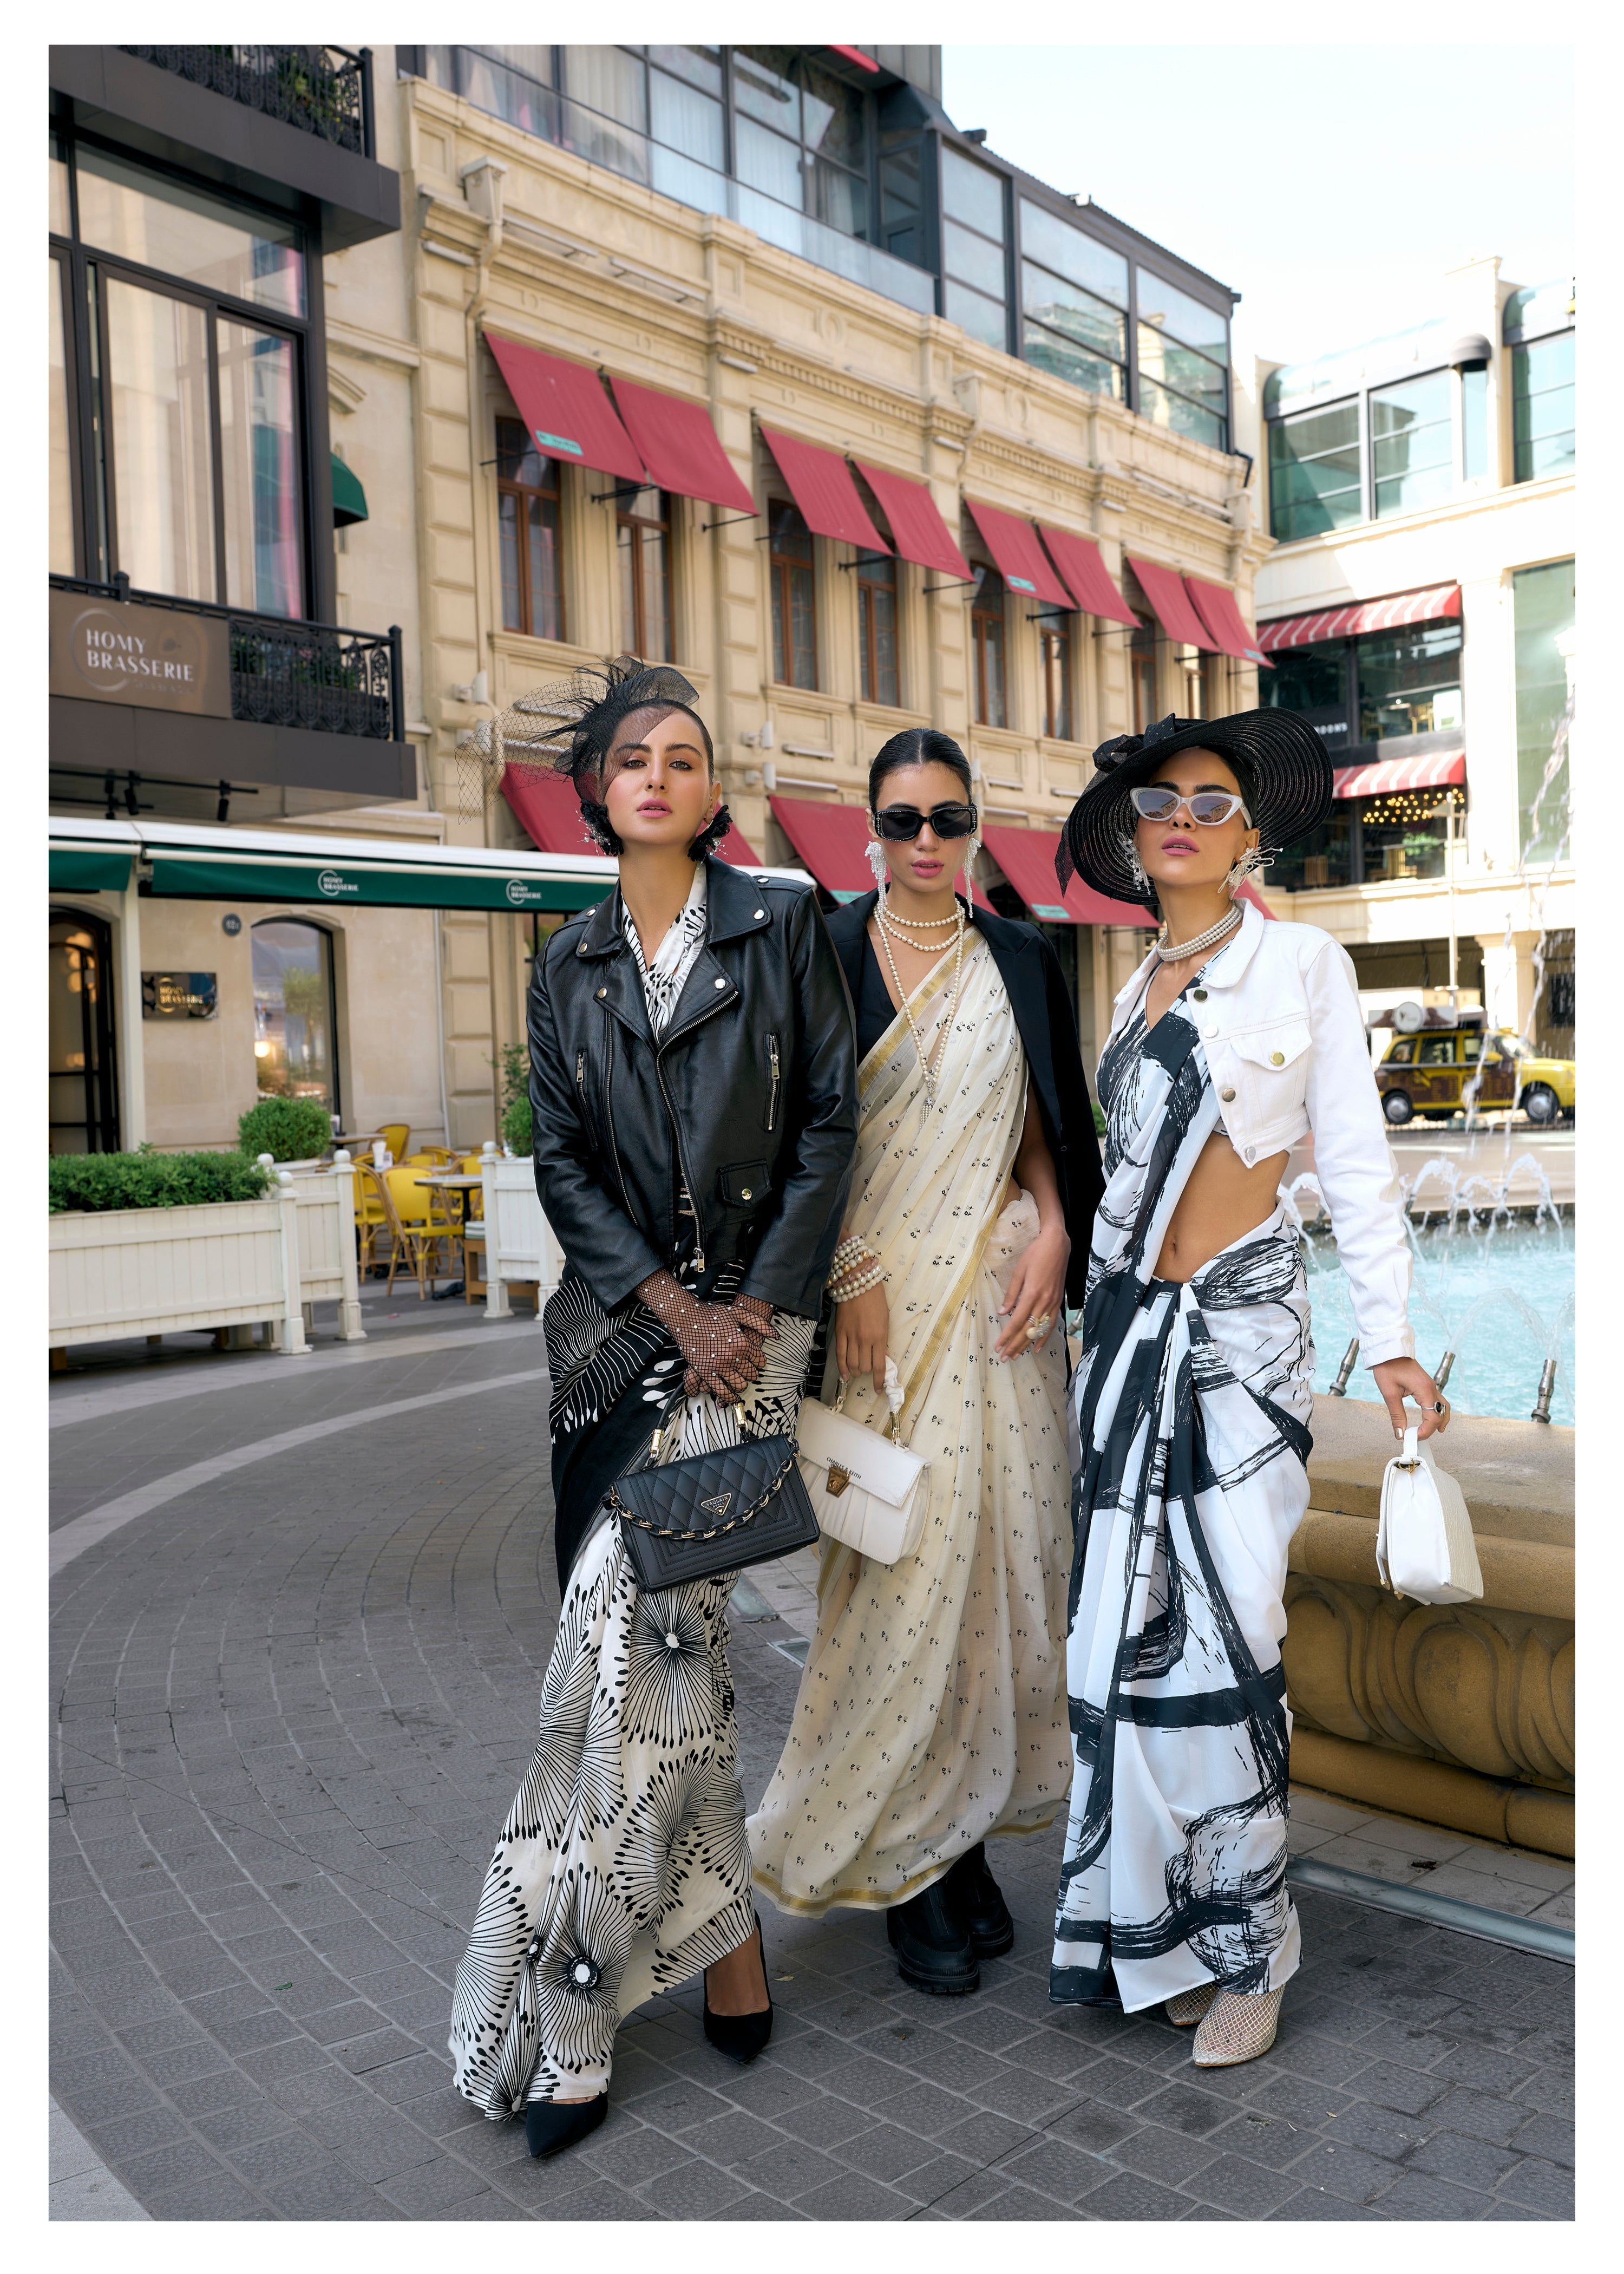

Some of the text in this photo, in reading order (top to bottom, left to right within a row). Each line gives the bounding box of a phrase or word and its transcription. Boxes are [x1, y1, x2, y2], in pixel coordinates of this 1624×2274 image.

[86, 628, 146, 654] HOMY
[87, 650, 194, 682] BRASSERIE
[324, 883, 359, 892] BRASSERIE
[826, 1456, 844, 1469] CHARLES
[848, 1469, 862, 1479] KEITH
[706, 1496, 728, 1507] SAQLAIN
